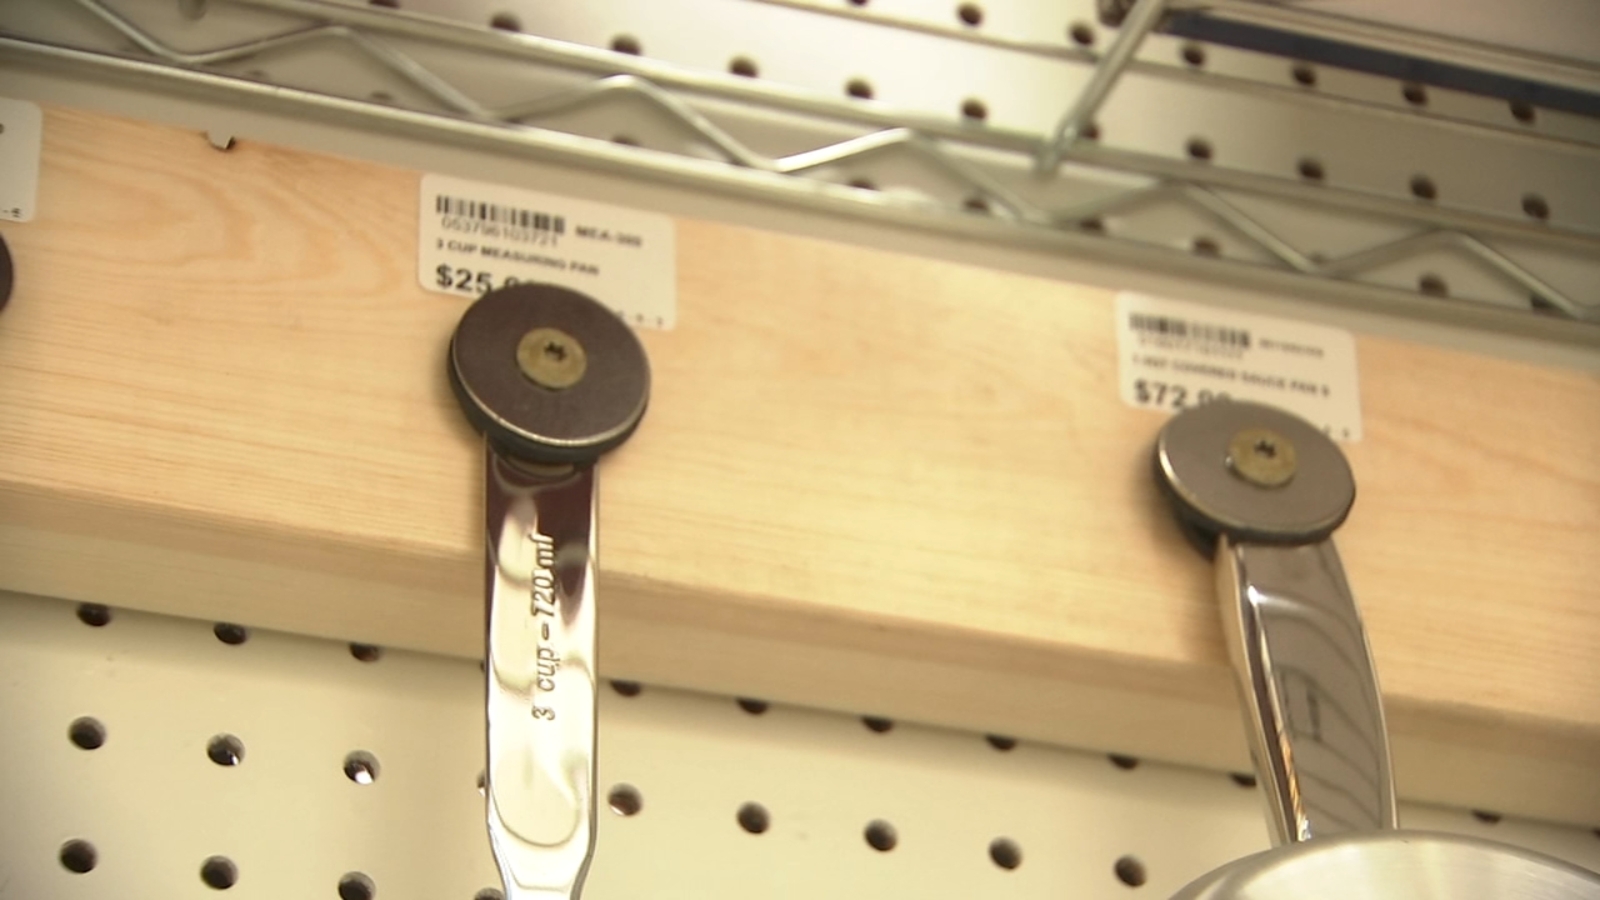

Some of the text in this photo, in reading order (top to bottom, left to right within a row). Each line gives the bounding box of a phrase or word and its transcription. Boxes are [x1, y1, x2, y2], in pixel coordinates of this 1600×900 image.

[447, 239, 478, 255] CUP
[481, 245, 567, 271] MEASURING
[569, 260, 600, 277] PAN
[536, 648, 560, 692] cup
[531, 705, 556, 722] 3
